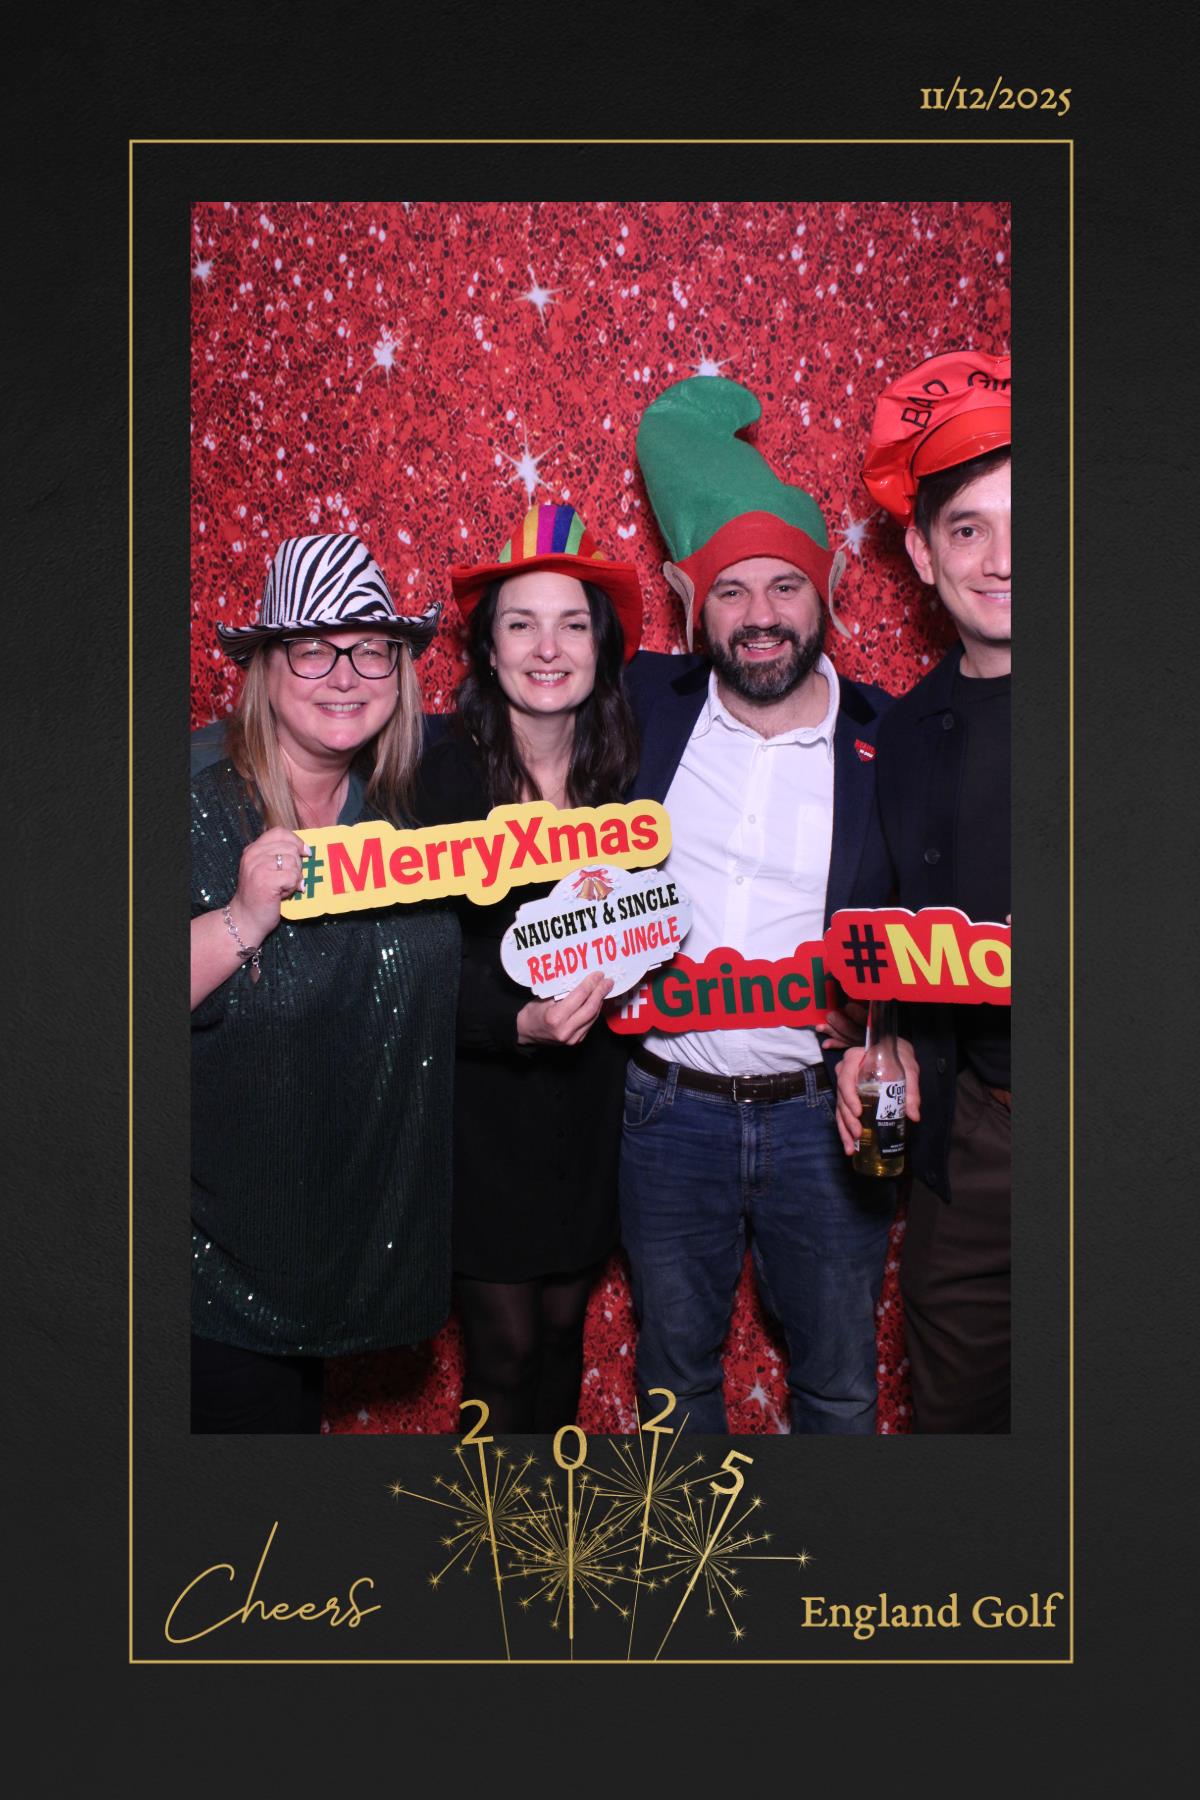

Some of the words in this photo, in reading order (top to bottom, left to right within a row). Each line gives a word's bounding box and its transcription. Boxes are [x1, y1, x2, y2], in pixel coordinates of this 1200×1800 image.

[901, 379, 949, 429] BAD
[294, 813, 659, 900] #MerryXmas
[513, 906, 598, 950] NAUGHTY
[602, 902, 617, 925] &
[617, 883, 680, 921] SINGLE
[527, 942, 588, 986] READY
[591, 935, 617, 965] TO
[621, 916, 681, 957] JINGLE
[841, 923, 1011, 988] #Mo
